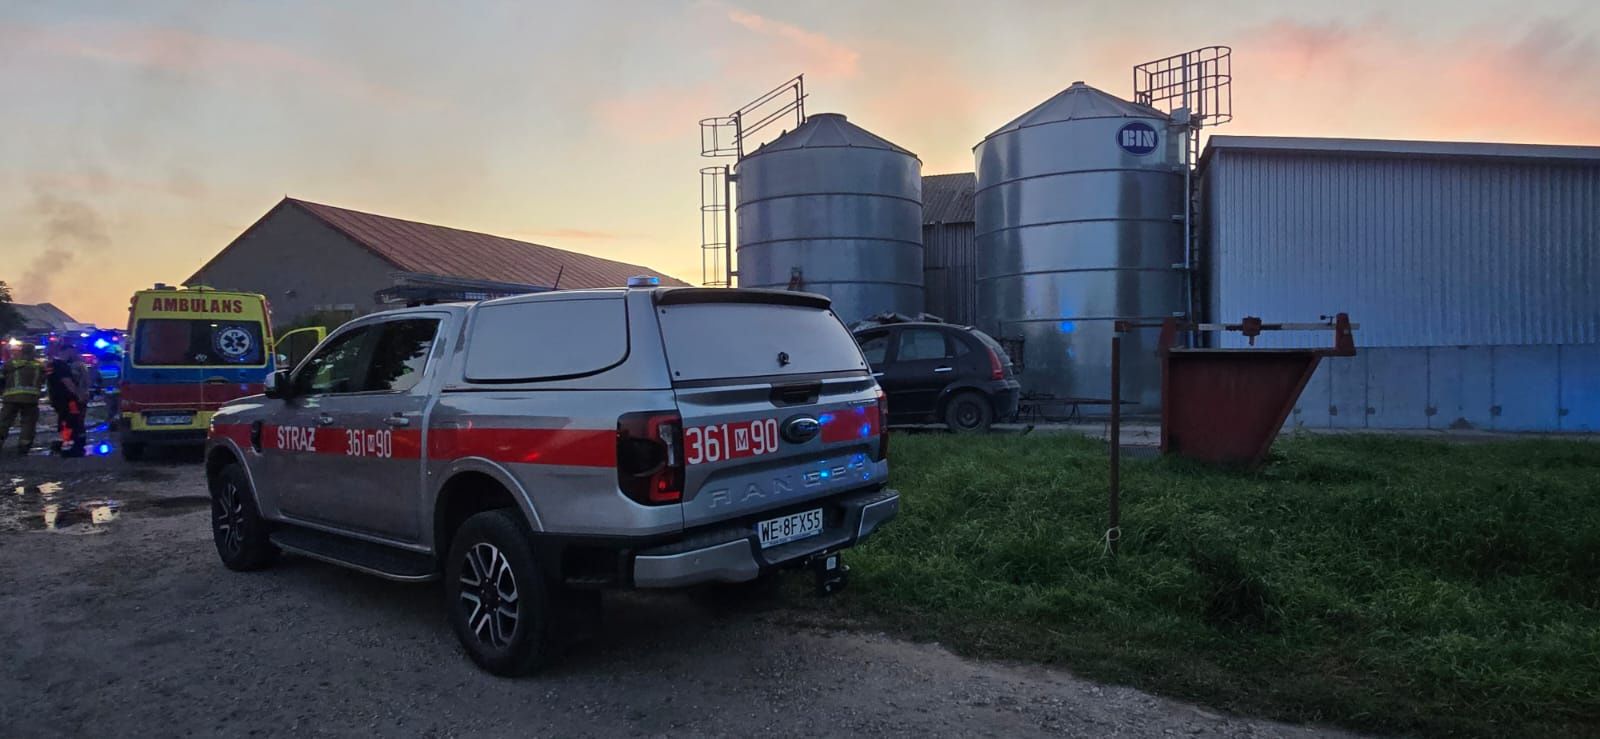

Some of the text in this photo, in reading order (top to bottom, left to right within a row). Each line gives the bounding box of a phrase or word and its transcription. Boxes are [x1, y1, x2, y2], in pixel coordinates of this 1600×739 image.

[1122, 129, 1155, 148] BIN
[152, 297, 243, 313] AMBULANS
[345, 428, 366, 457] 361
[375, 430, 392, 459] 90
[685, 423, 730, 465] 361
[750, 418, 779, 455] 90
